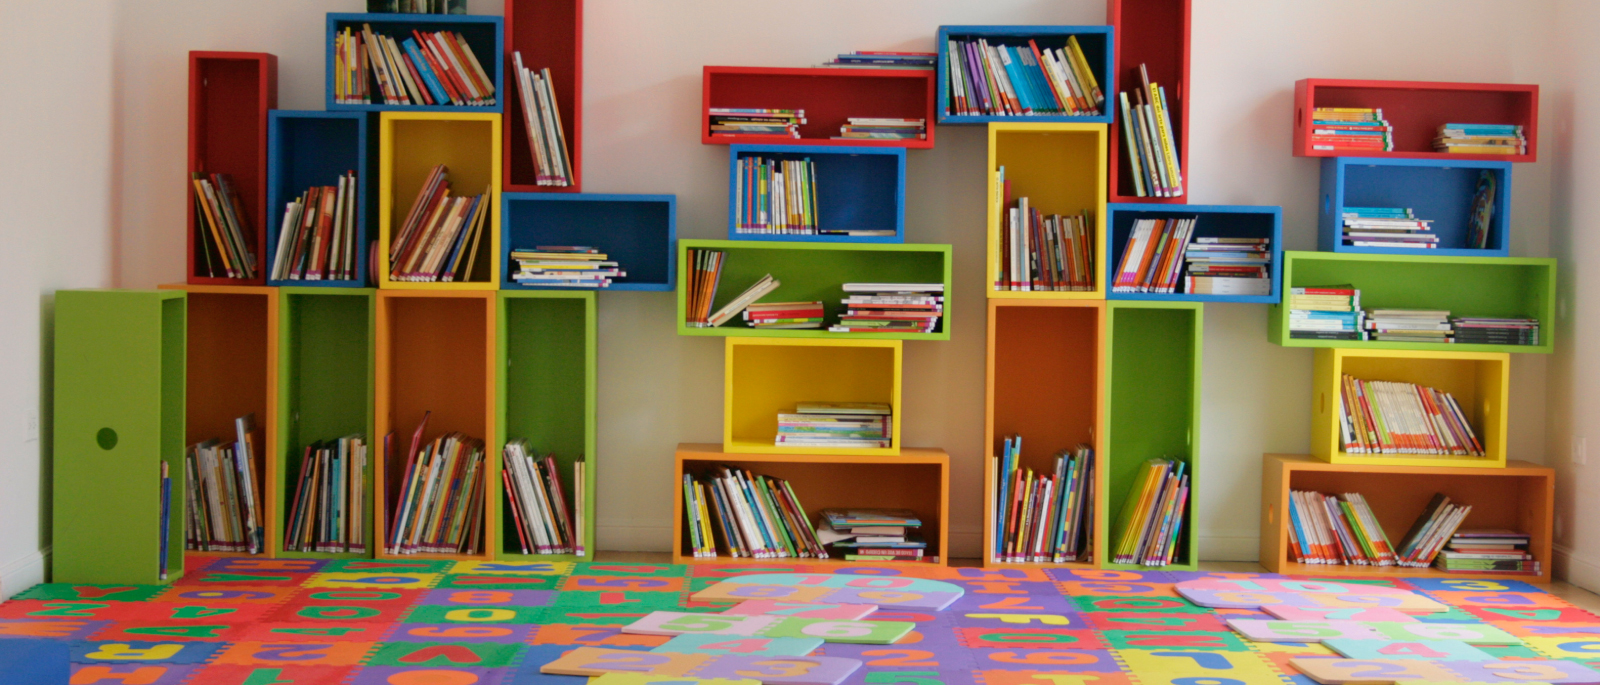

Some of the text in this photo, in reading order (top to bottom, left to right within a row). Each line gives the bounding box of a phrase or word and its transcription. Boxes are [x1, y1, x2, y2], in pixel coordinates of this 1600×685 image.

[447, 591, 515, 604] 8
[727, 586, 800, 598] 8
[857, 591, 925, 604] 9
[1213, 592, 1284, 604] 8
[764, 602, 842, 616] 7
[1336, 596, 1404, 607] 9
[1298, 607, 1367, 620] 7
[658, 615, 748, 632] 5
[801, 621, 878, 638] 6
[1266, 621, 1344, 637] 5
[1402, 623, 1484, 640] 6
[696, 638, 774, 653] 4
[1376, 642, 1451, 658] 4
[577, 653, 672, 672] 2
[861, 648, 940, 667] 2
[734, 660, 821, 678] 3
[1331, 661, 1424, 679] 2
[1482, 663, 1569, 681] 3
